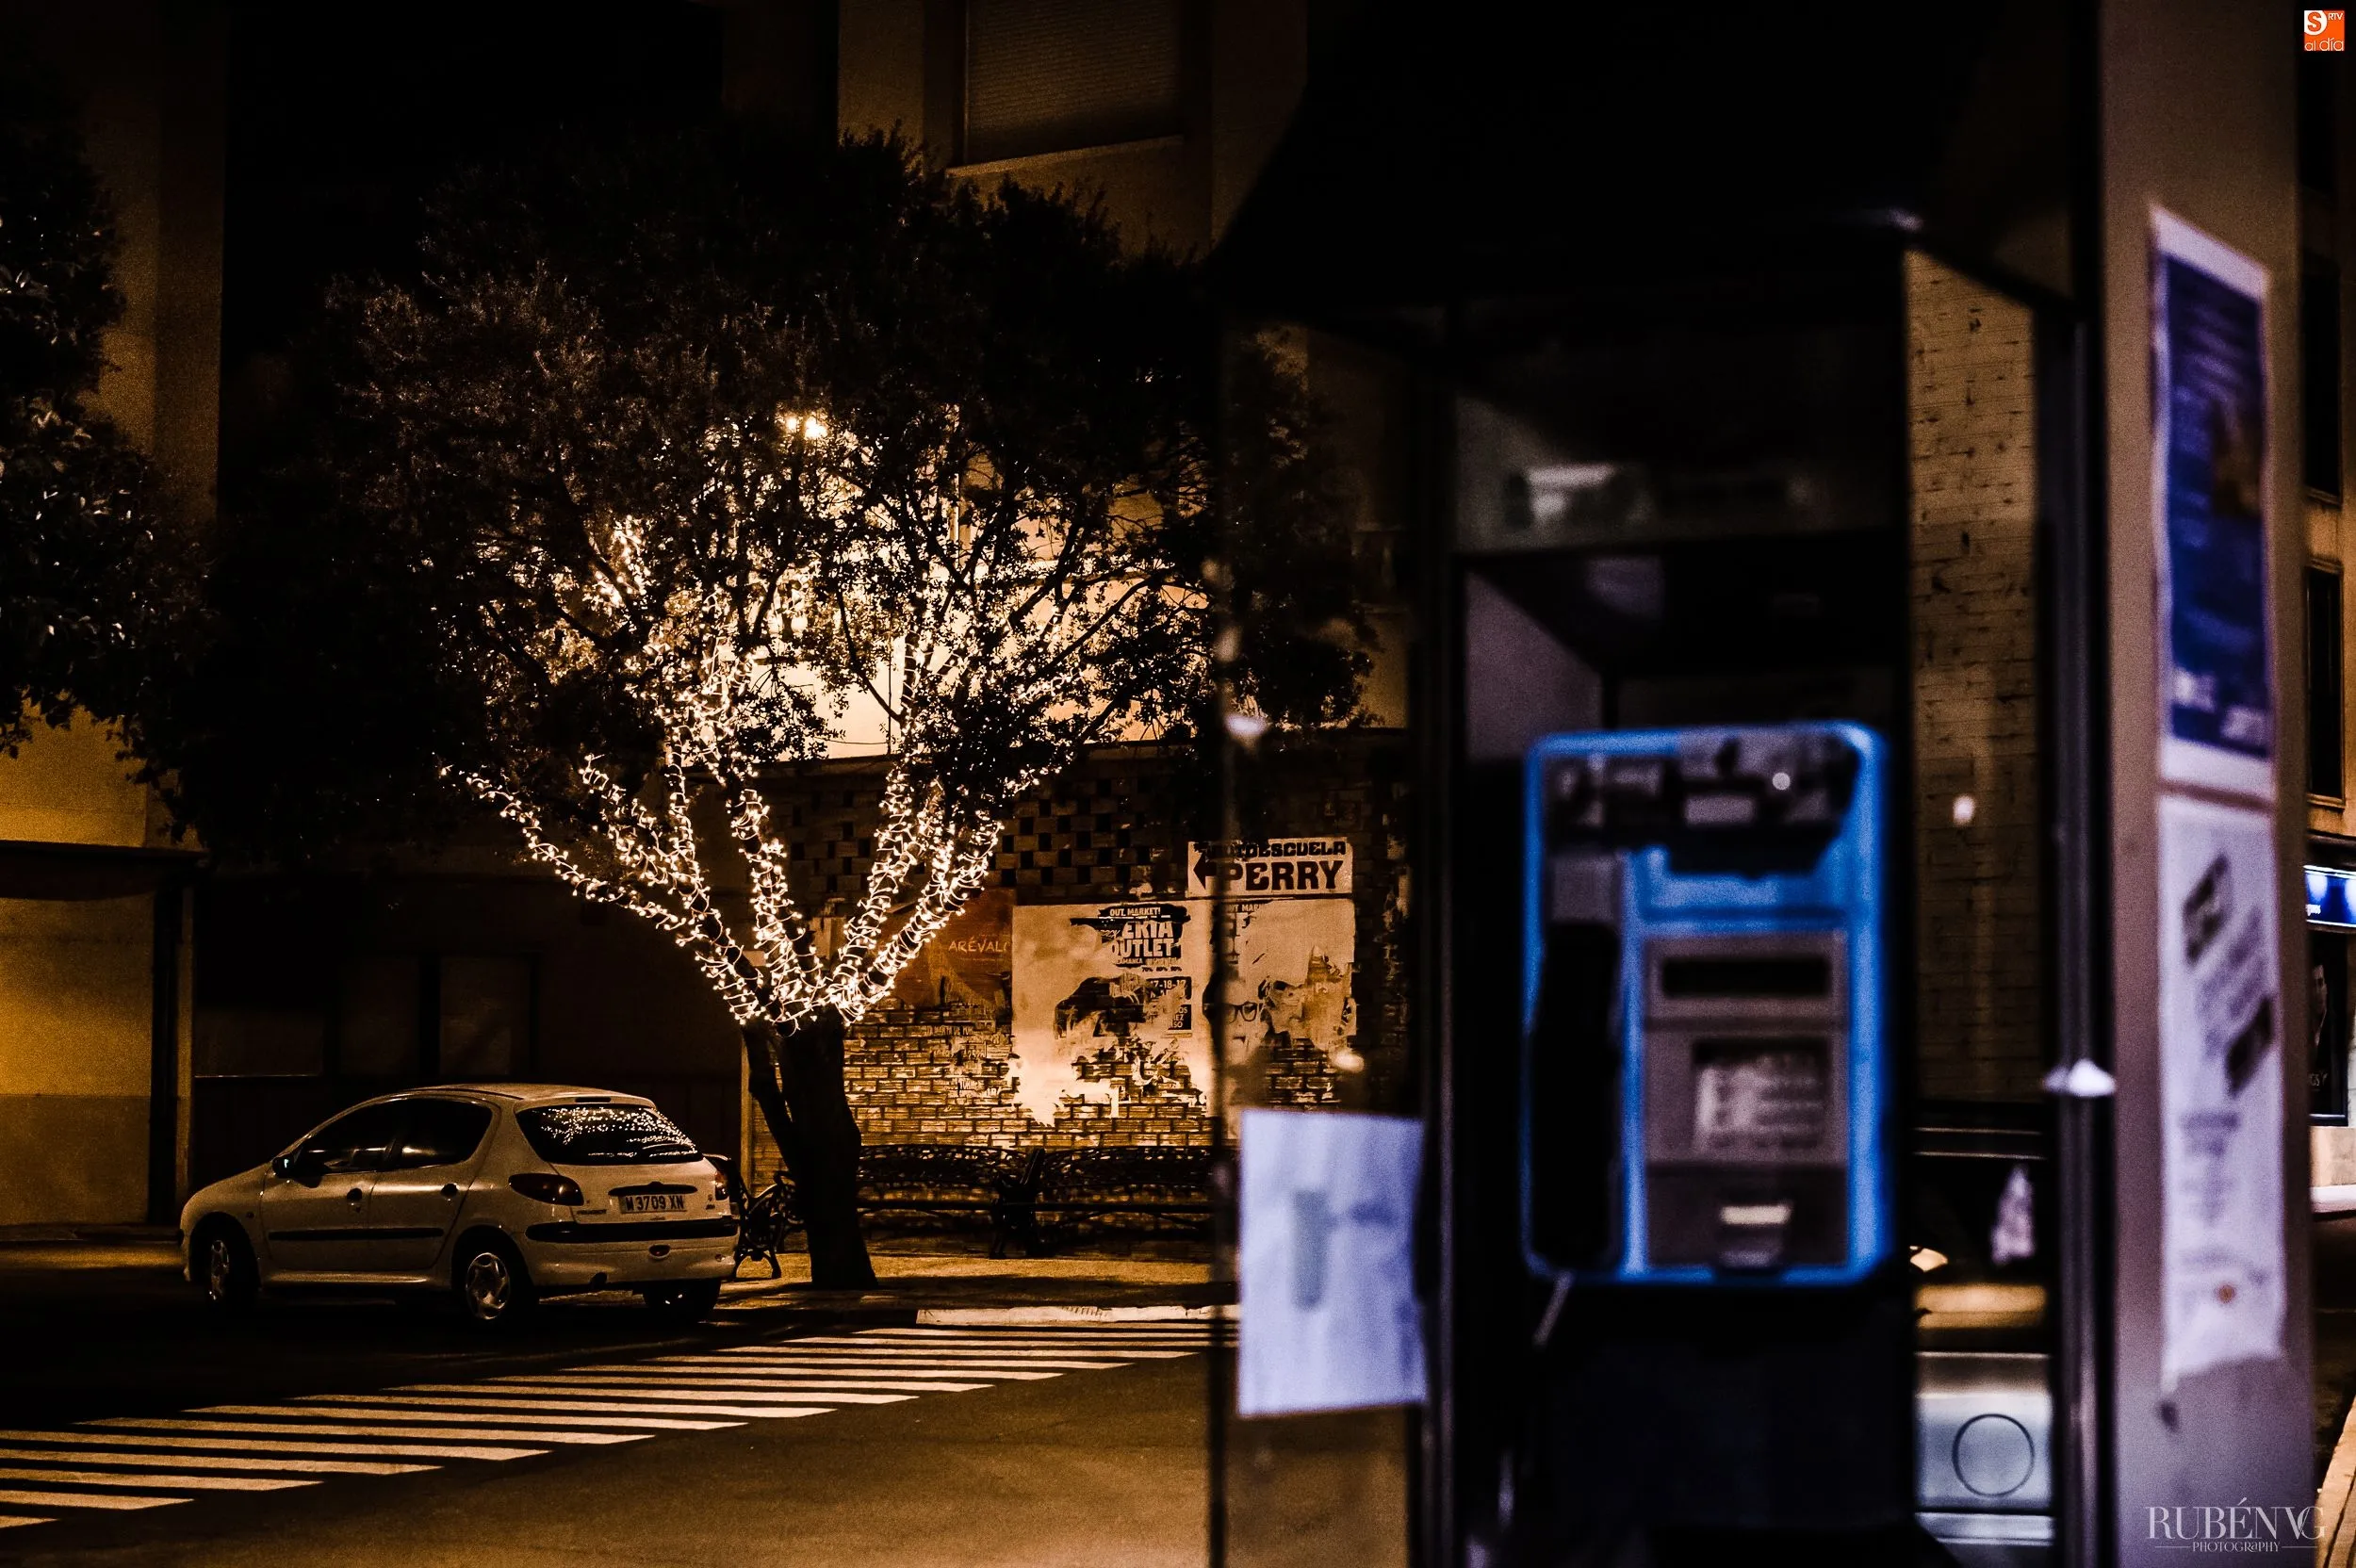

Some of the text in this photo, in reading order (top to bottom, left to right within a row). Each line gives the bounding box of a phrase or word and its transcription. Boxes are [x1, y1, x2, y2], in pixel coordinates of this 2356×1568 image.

[1224, 860, 1344, 891] PERRY
[1110, 938, 1175, 958] OUTLET
[636, 1195, 667, 1211] 3709
[669, 1194, 685, 1210] XN
